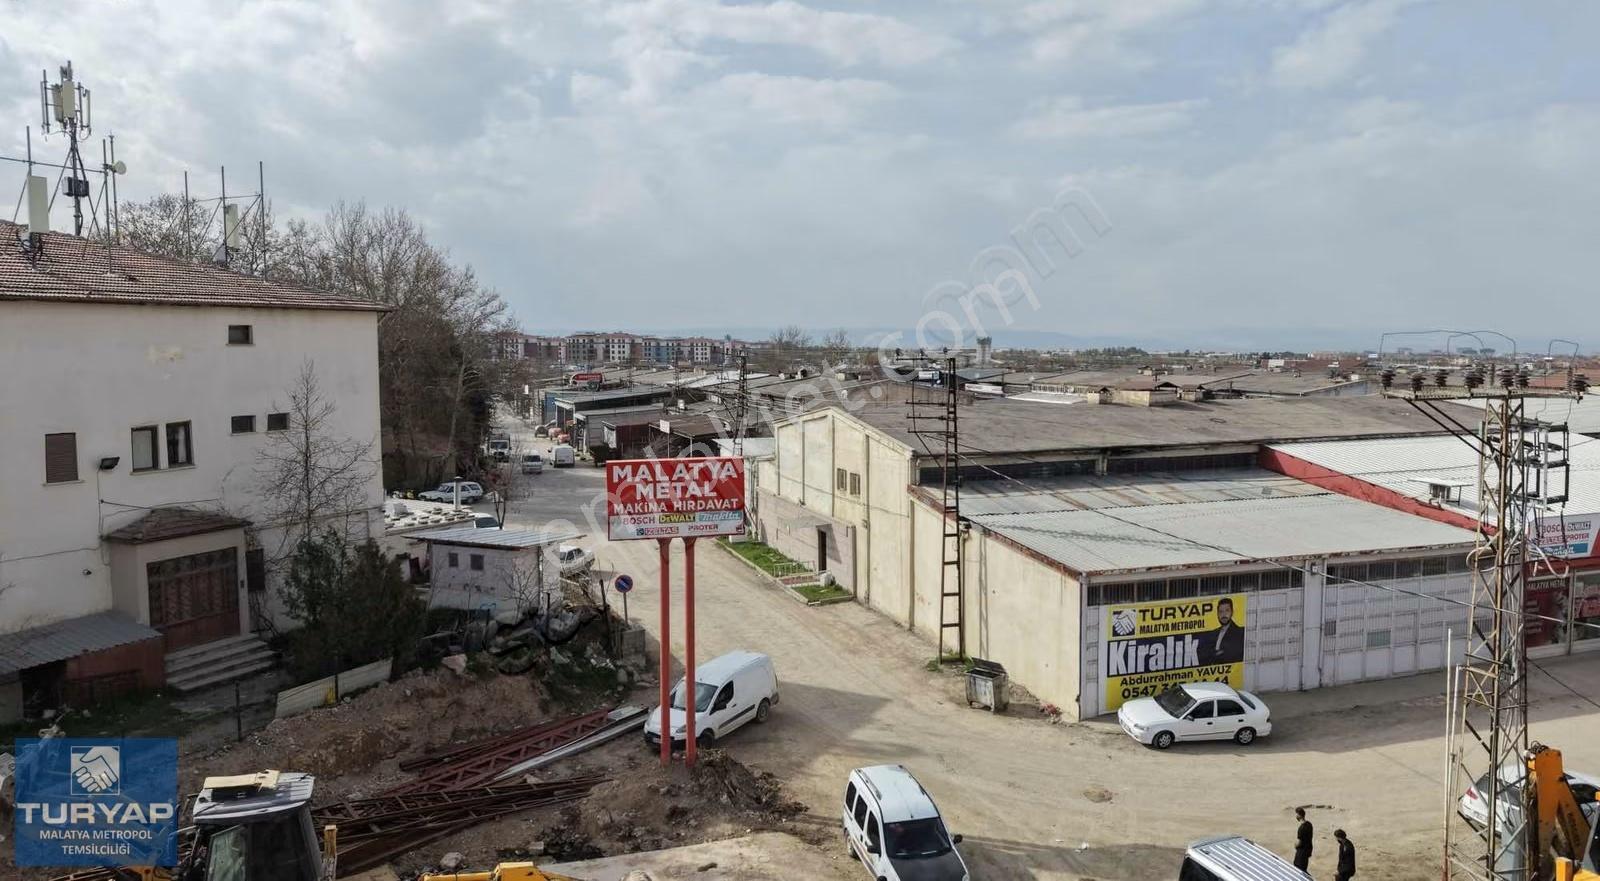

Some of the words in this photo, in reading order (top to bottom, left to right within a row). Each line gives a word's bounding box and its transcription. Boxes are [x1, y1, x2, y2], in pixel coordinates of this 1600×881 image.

[612, 461, 738, 483] MALATYA
[635, 480, 718, 500] METAL
[673, 498, 739, 512] HIRDAVAT
[622, 517, 656, 526] BOSCH
[1138, 603, 1214, 622] TURYAP
[1139, 621, 1171, 635] MALATYA
[1171, 619, 1206, 632] METROPOL
[1108, 634, 1200, 676] Kiralık
[1120, 670, 1194, 687] Abdurrahman
[1197, 665, 1232, 677] YAVUZ
[1121, 685, 1157, 700] 0547
